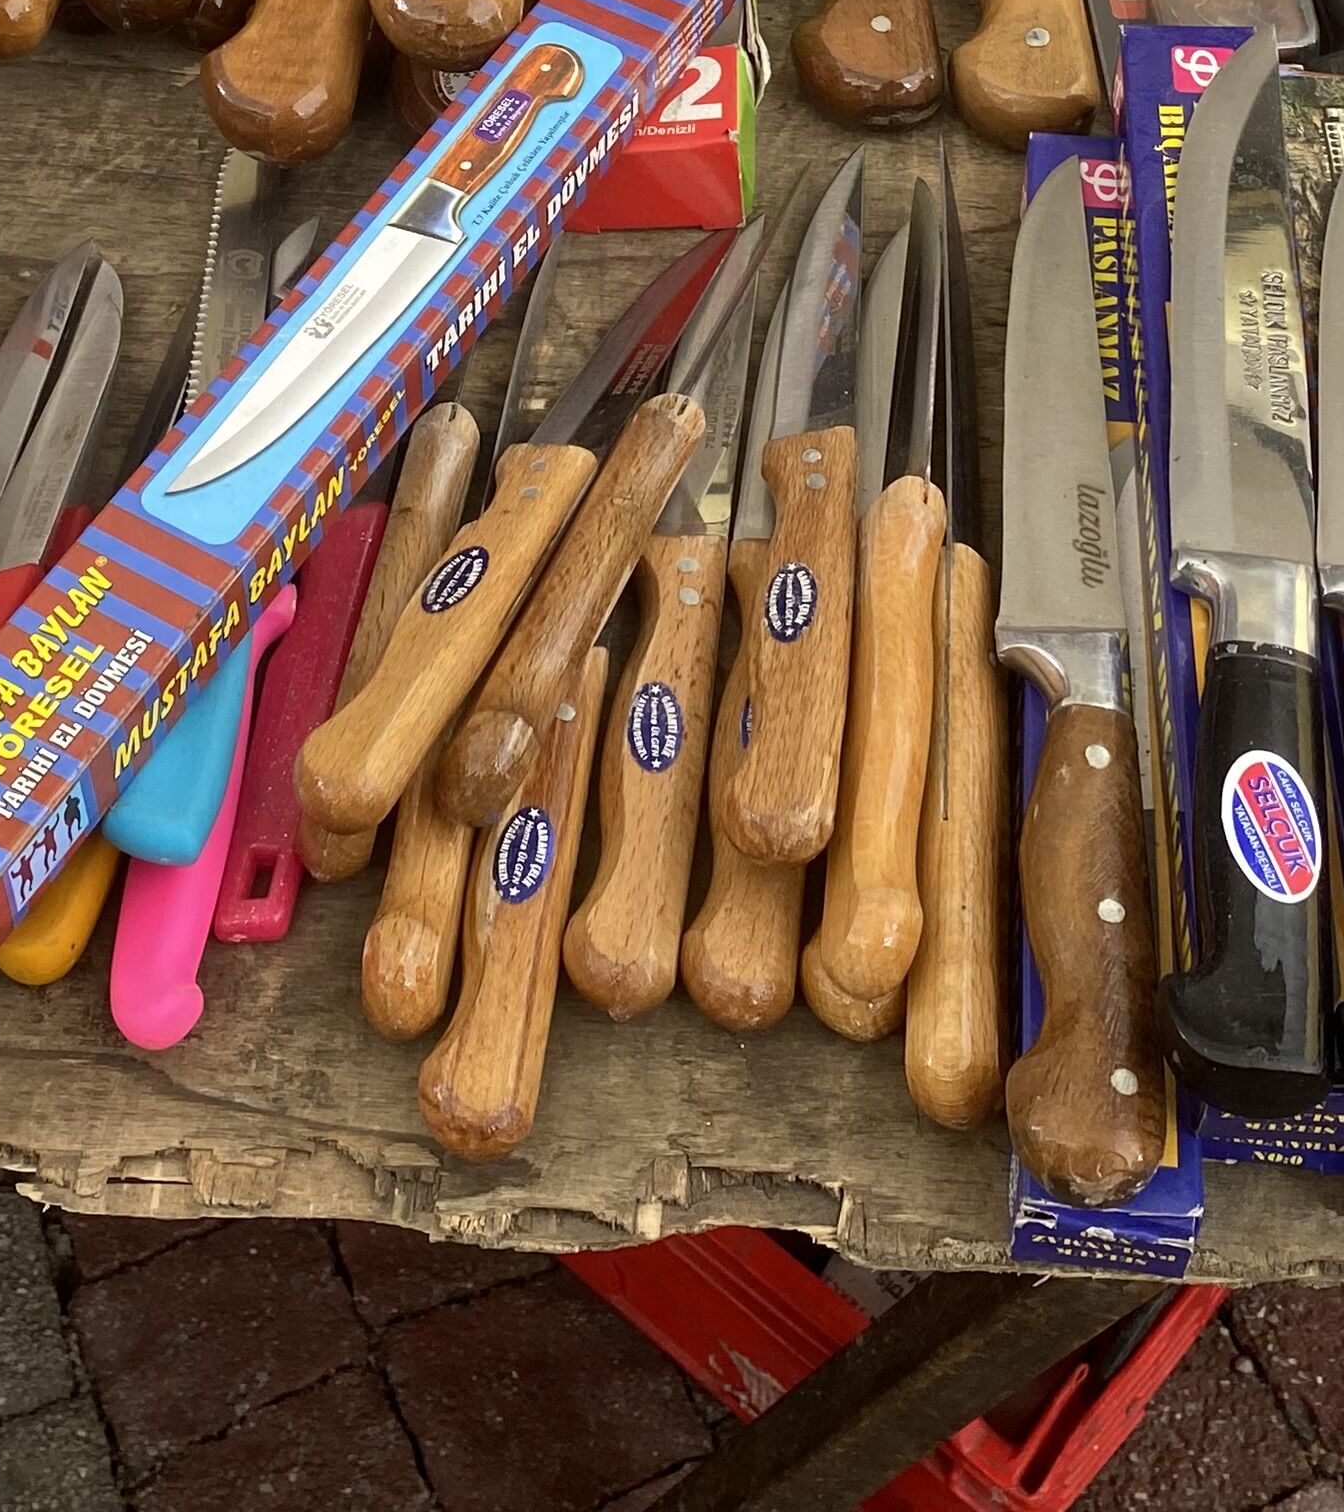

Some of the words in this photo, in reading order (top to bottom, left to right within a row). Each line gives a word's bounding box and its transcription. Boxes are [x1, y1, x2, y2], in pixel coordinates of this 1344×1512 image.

[477, 93, 517, 136] YÖRESEL
[658, 54, 725, 124] 2
[424, 255, 508, 376] TARİHİ
[511, 224, 542, 269] EL
[546, 88, 643, 221] DÖVMESİ
[1091, 215, 1121, 403] PASLANMAZ
[349, 388, 408, 473] YÖRESEL
[1076, 482, 1106, 590] lazoğlu
[11, 564, 114, 680] BAYLAN
[112, 599, 242, 782] MUSTAFA
[248, 464, 347, 607] BAYLAN
[48, 720, 84, 750] EL
[72, 626, 156, 720] DÖVMESİ
[1247, 776, 1314, 879] SELÇUK
[1276, 769, 1301, 805] CAHİT
[1289, 800, 1315, 844] SELÇUK
